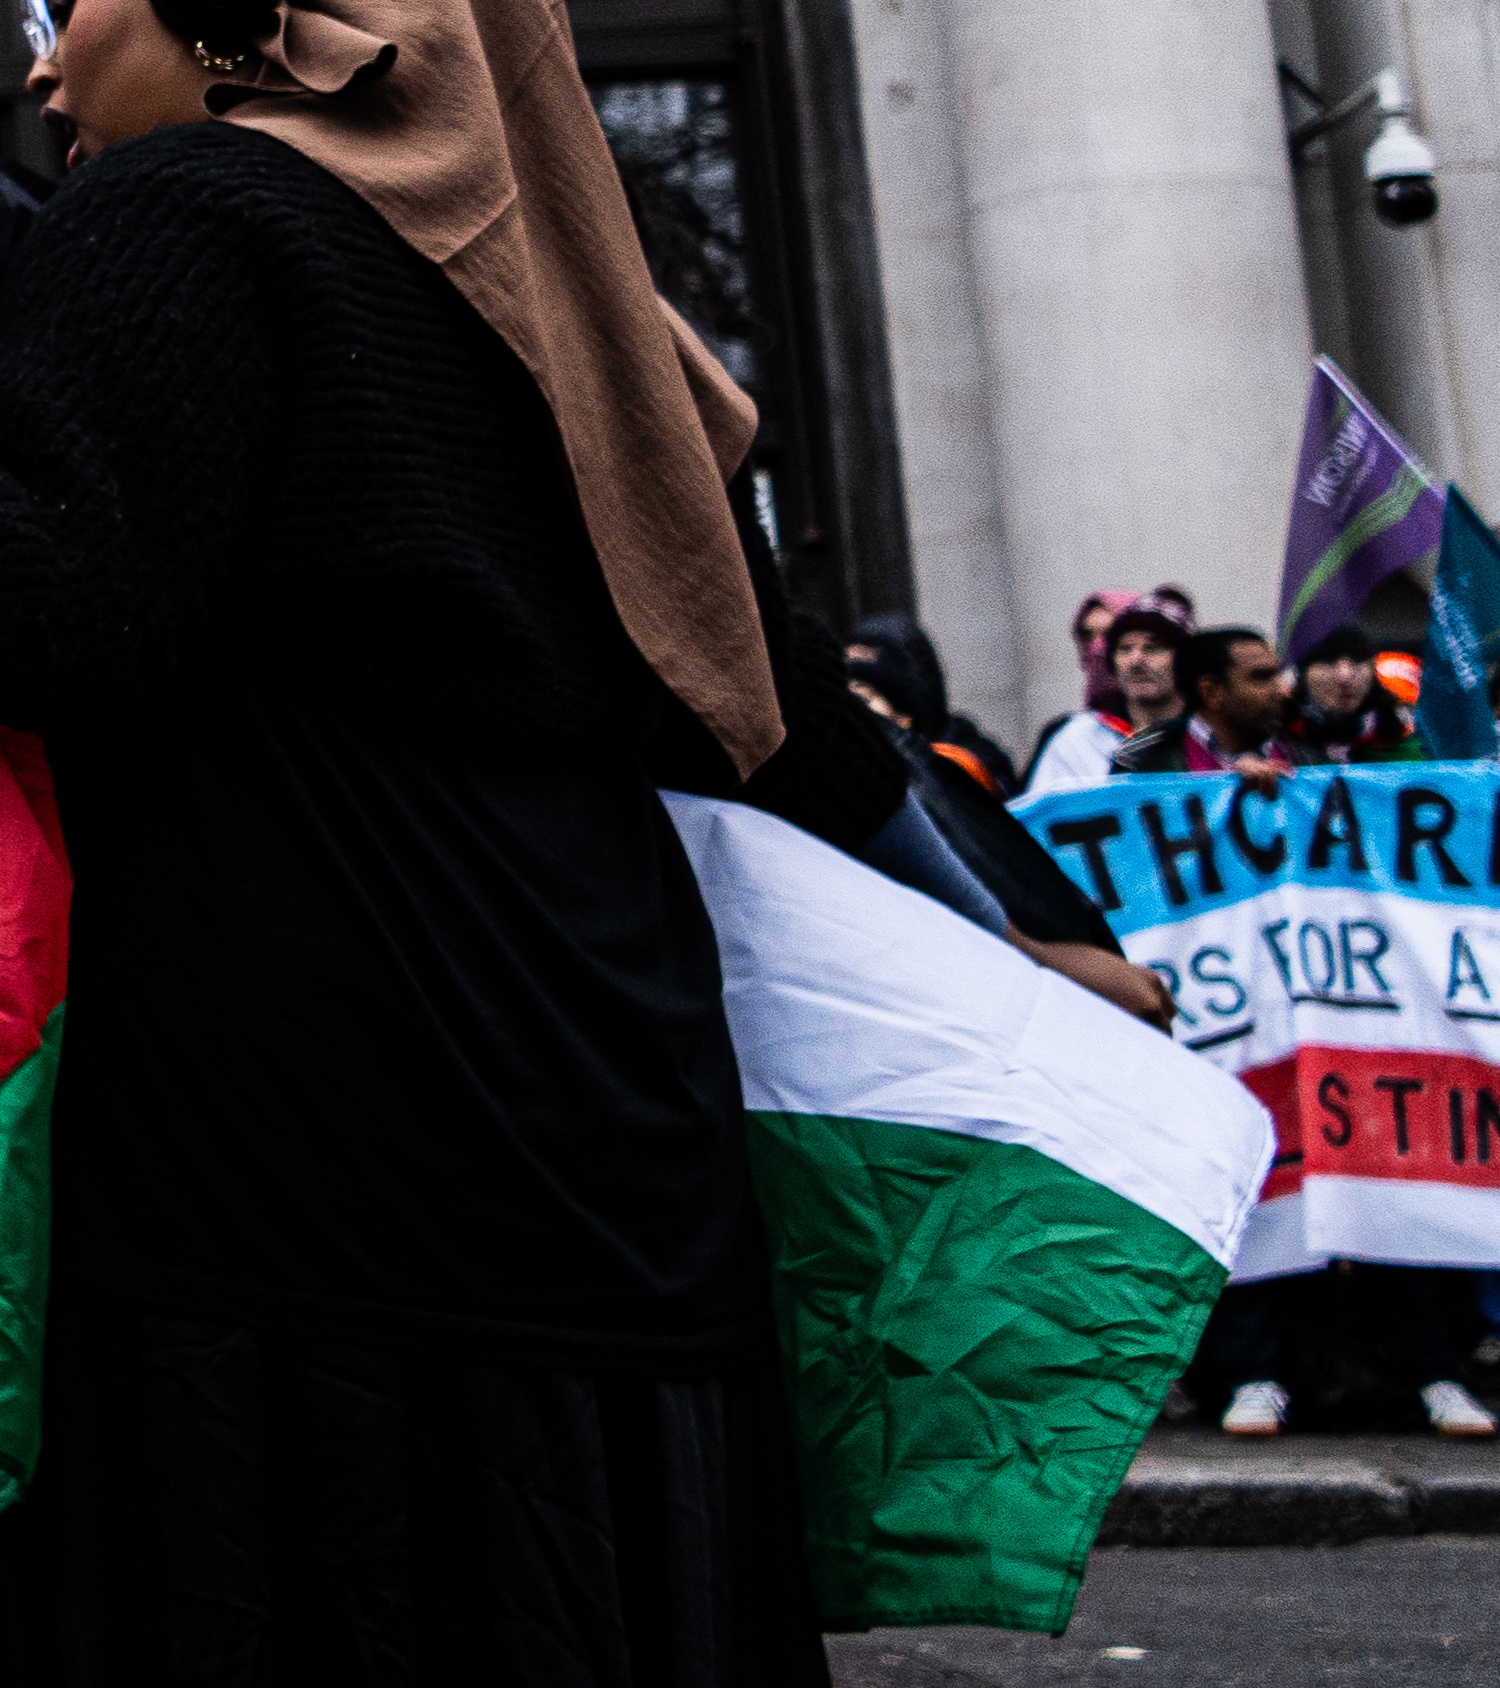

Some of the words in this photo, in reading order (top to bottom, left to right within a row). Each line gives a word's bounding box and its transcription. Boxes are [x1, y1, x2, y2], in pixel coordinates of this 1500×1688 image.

[1048, 774, 1500, 912] THCAR
[1262, 919, 1391, 998] FOR
[1446, 928, 1491, 1002] A
